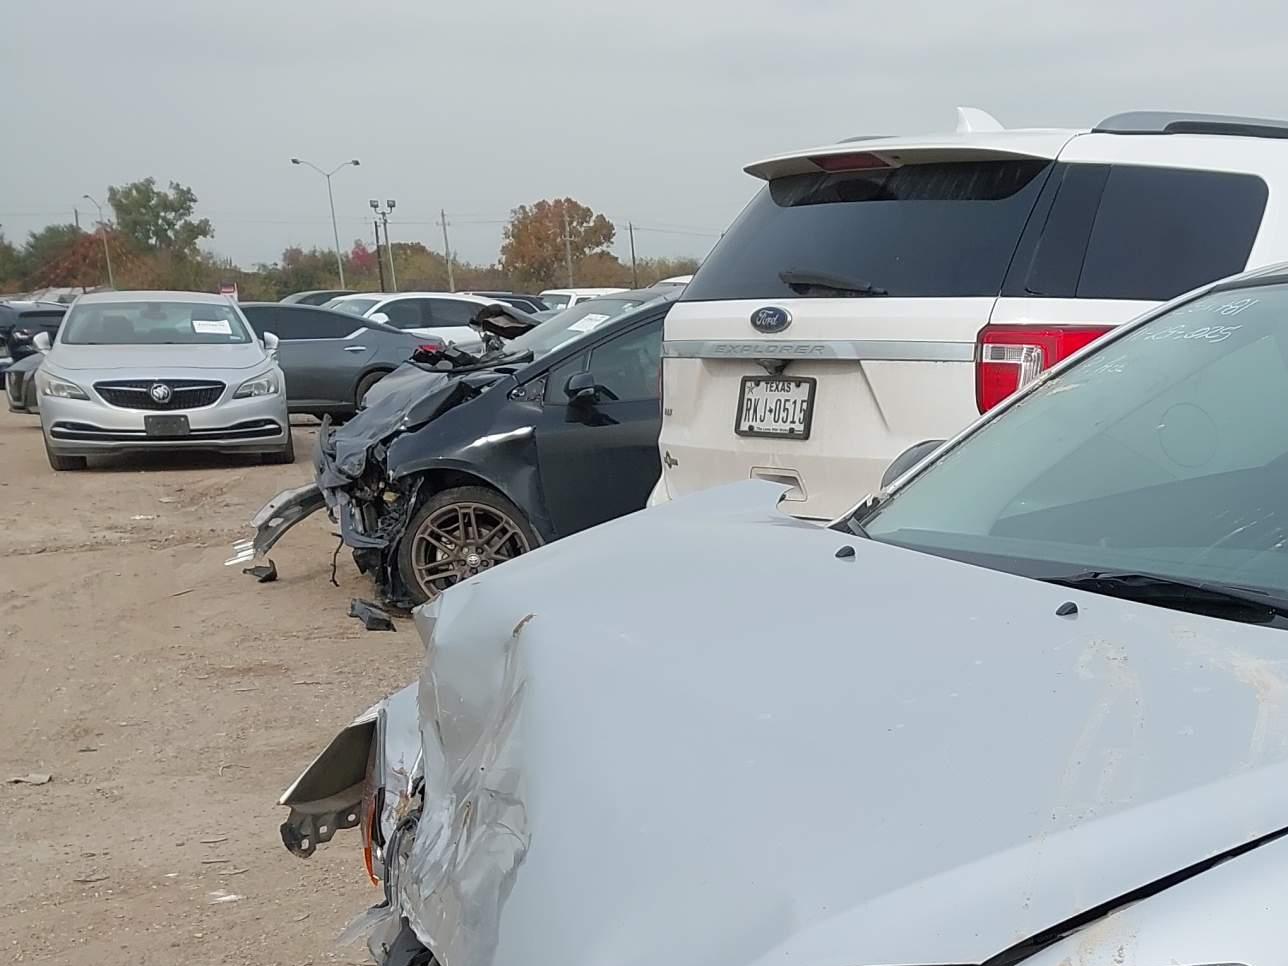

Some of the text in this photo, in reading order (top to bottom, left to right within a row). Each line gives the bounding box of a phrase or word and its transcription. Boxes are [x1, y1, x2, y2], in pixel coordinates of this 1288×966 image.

[756, 310, 780, 325] Ford
[714, 344, 825, 354] EXPLORER
[765, 382, 791, 393] TEXAS
